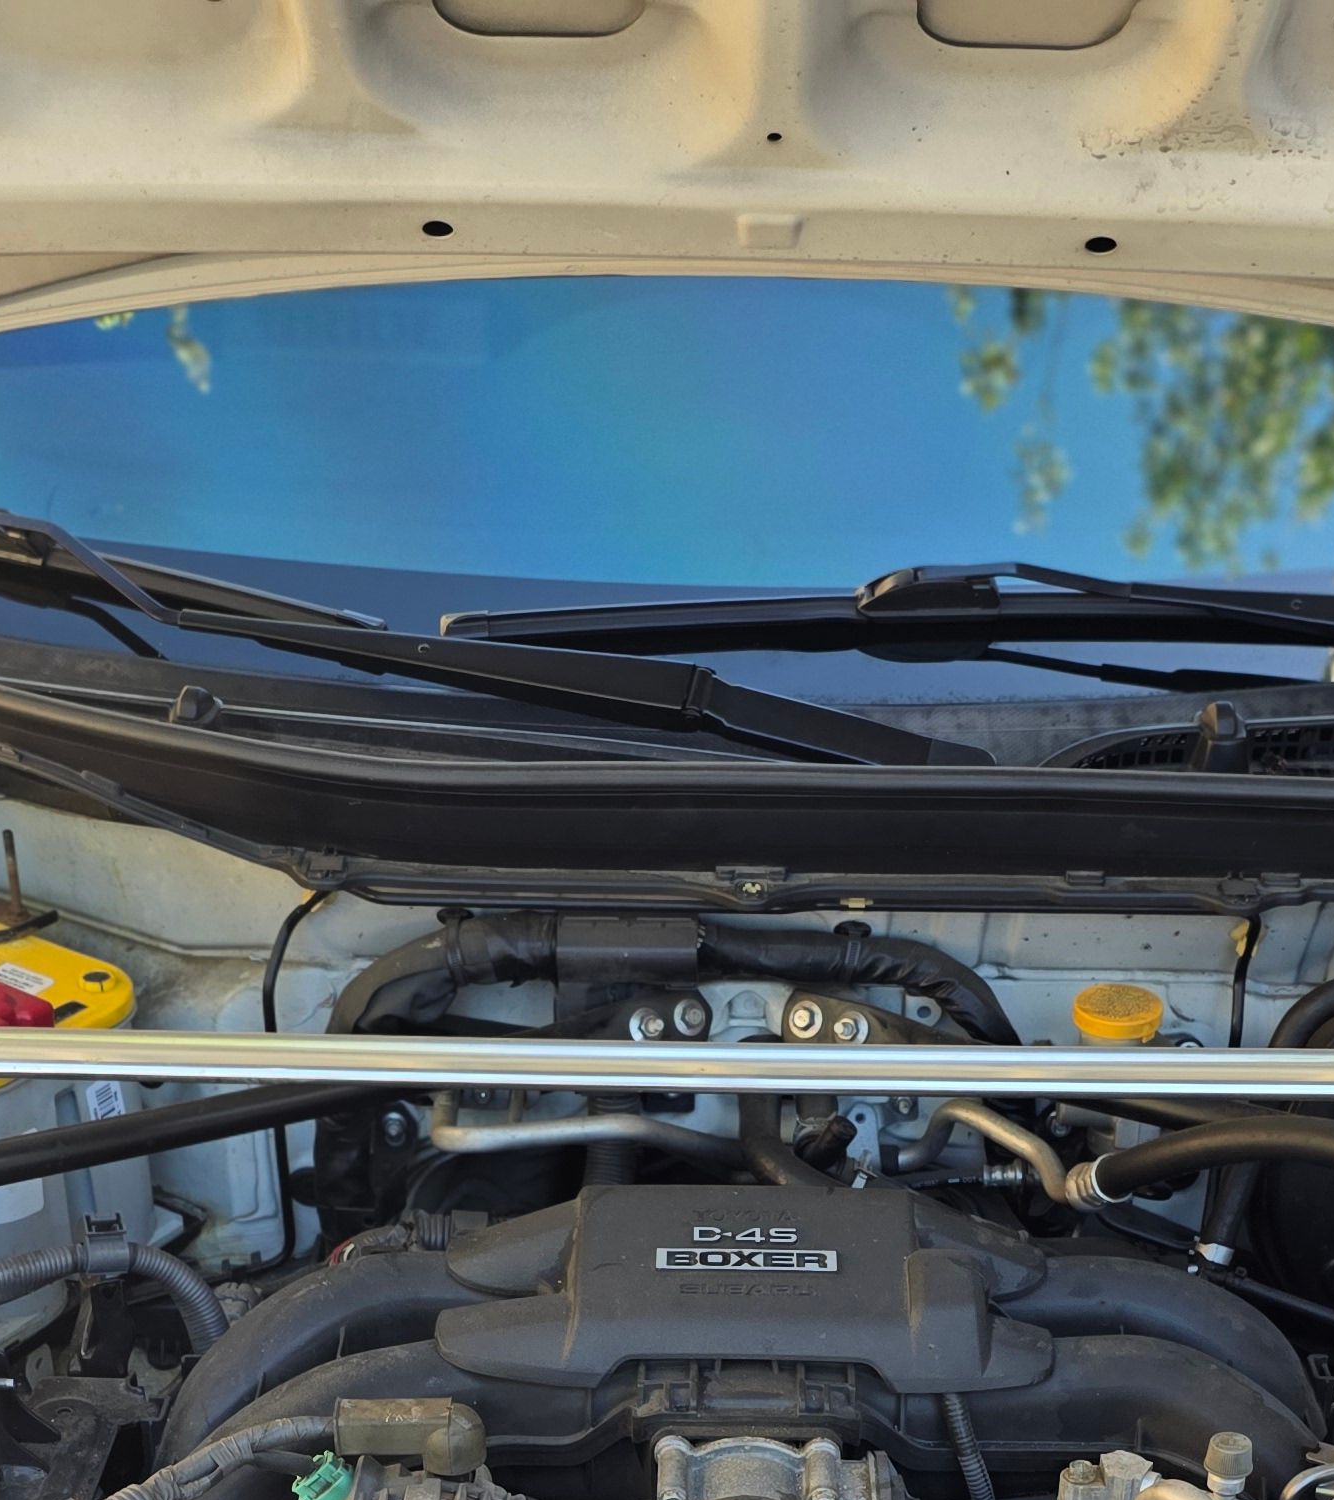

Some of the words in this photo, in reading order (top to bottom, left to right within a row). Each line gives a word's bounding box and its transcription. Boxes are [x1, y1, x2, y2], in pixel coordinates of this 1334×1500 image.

[692, 1208, 799, 1222] TOYOTA
[693, 1226, 798, 1243] D-4S
[666, 1250, 828, 1268] BOXER
[680, 1283, 817, 1296] SUBARU
